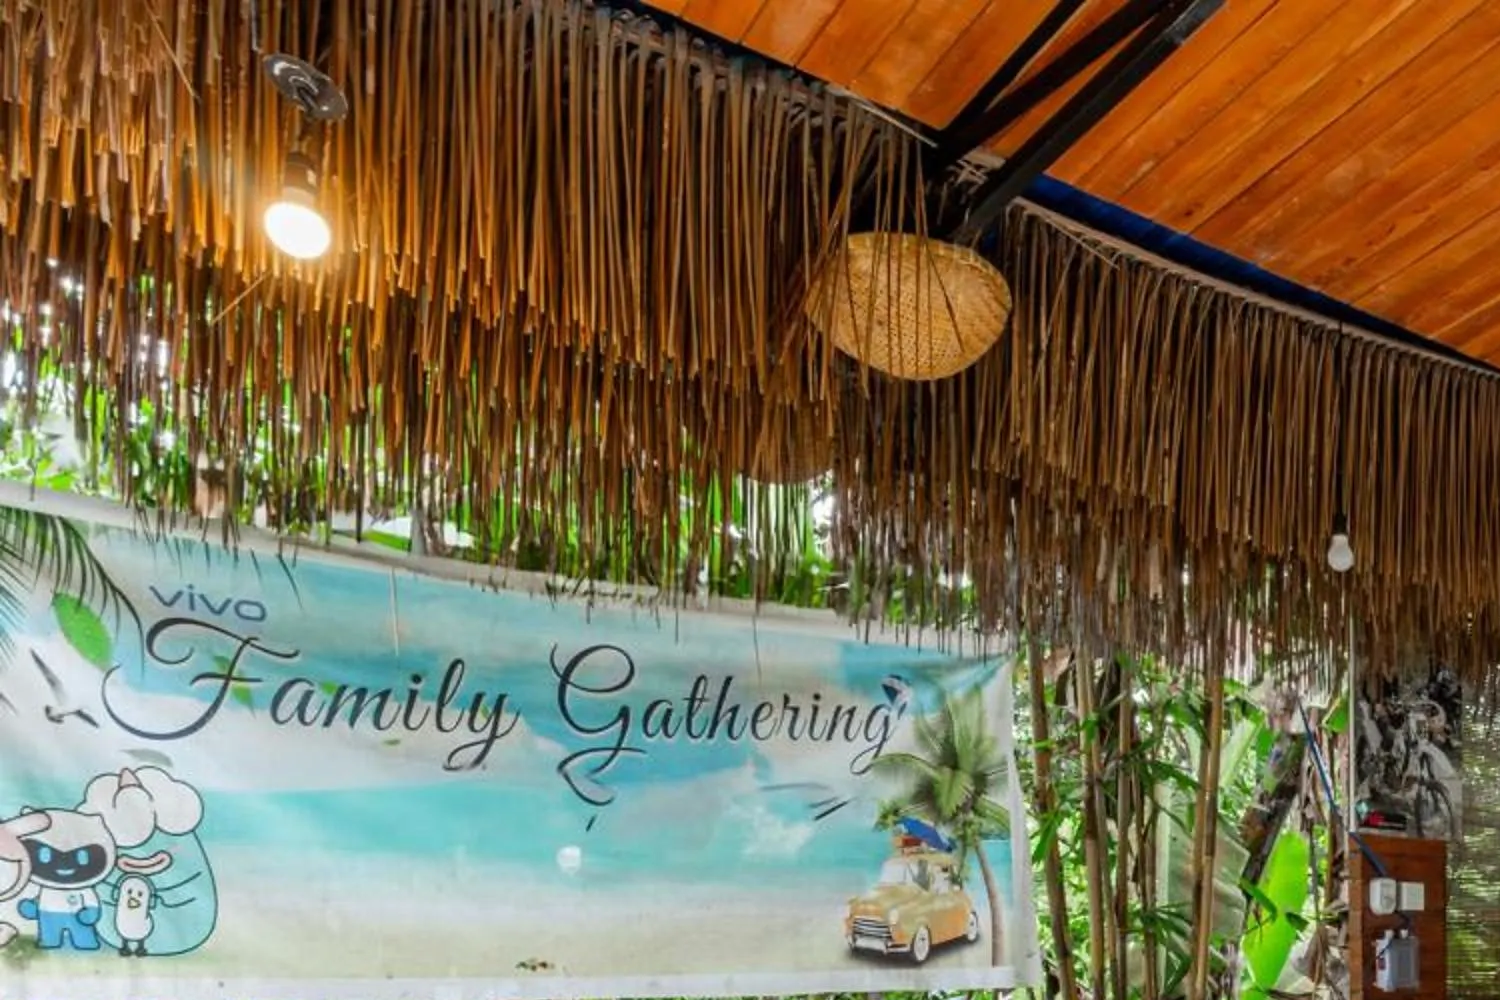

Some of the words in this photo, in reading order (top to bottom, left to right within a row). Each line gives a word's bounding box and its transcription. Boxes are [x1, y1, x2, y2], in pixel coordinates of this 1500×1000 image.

[149, 583, 267, 622] vivo
[102, 617, 521, 771] Family
[551, 643, 905, 776] Gathering
